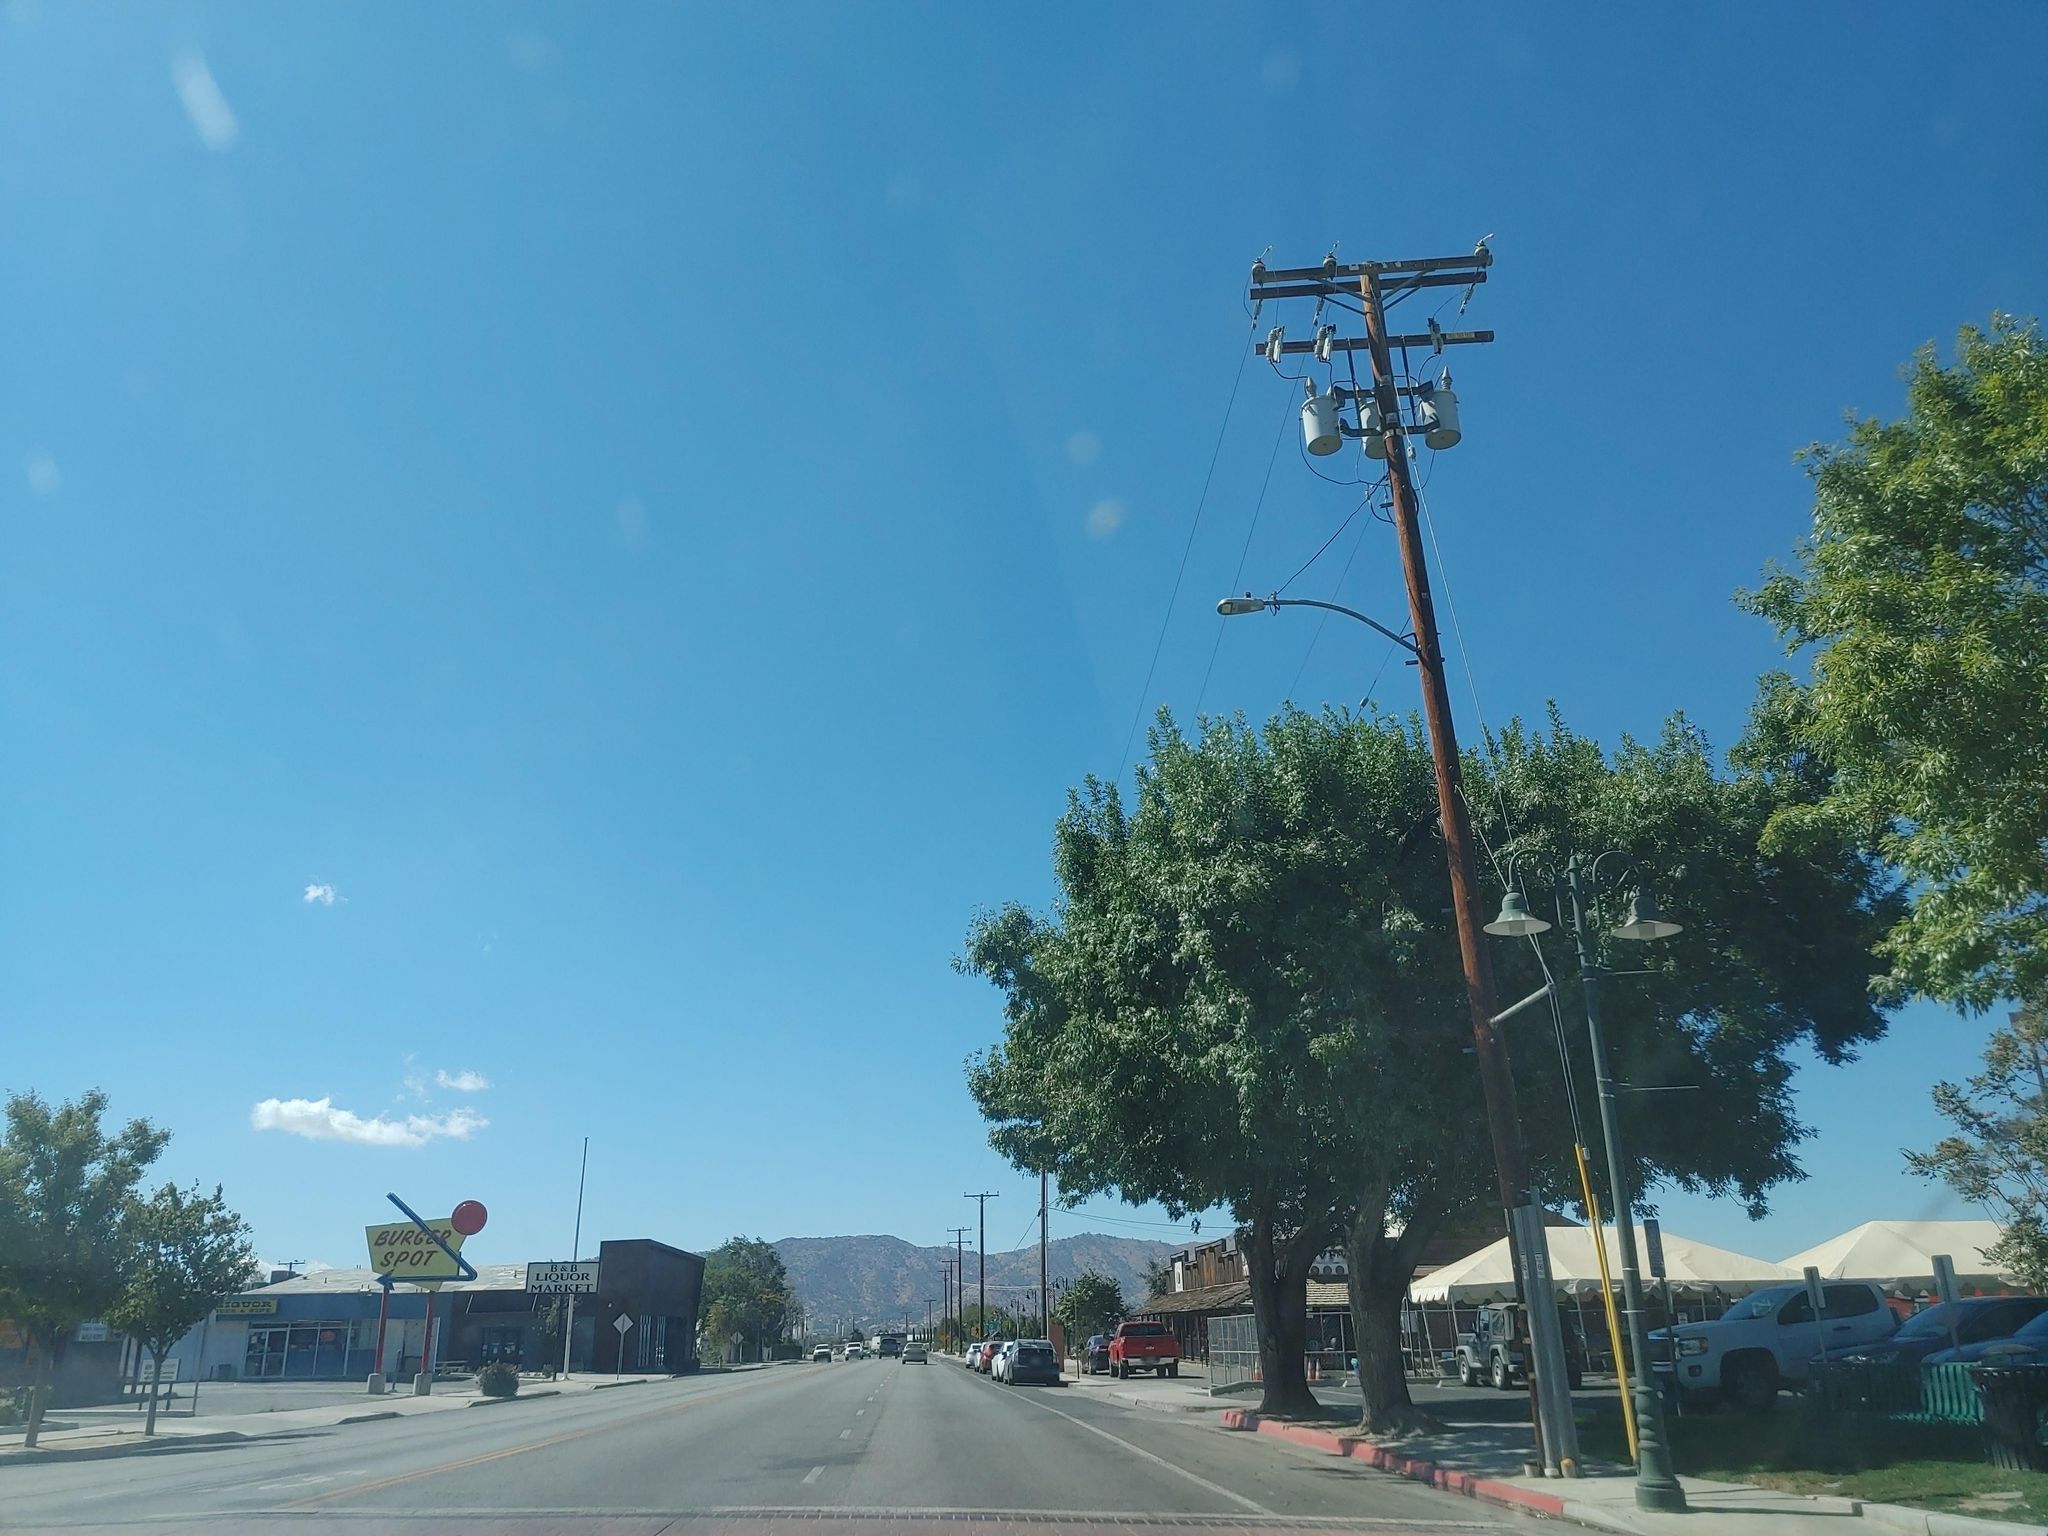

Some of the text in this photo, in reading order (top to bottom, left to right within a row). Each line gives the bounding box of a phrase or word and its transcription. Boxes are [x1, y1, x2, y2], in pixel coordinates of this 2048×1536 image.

[374, 1228, 452, 1247] BURGER
[380, 1250, 439, 1267] SPOT
[550, 1264, 558, 1272] B
[570, 1264, 578, 1272] B
[536, 1273, 590, 1282] LIQUOR
[531, 1284, 594, 1292] MARKET
